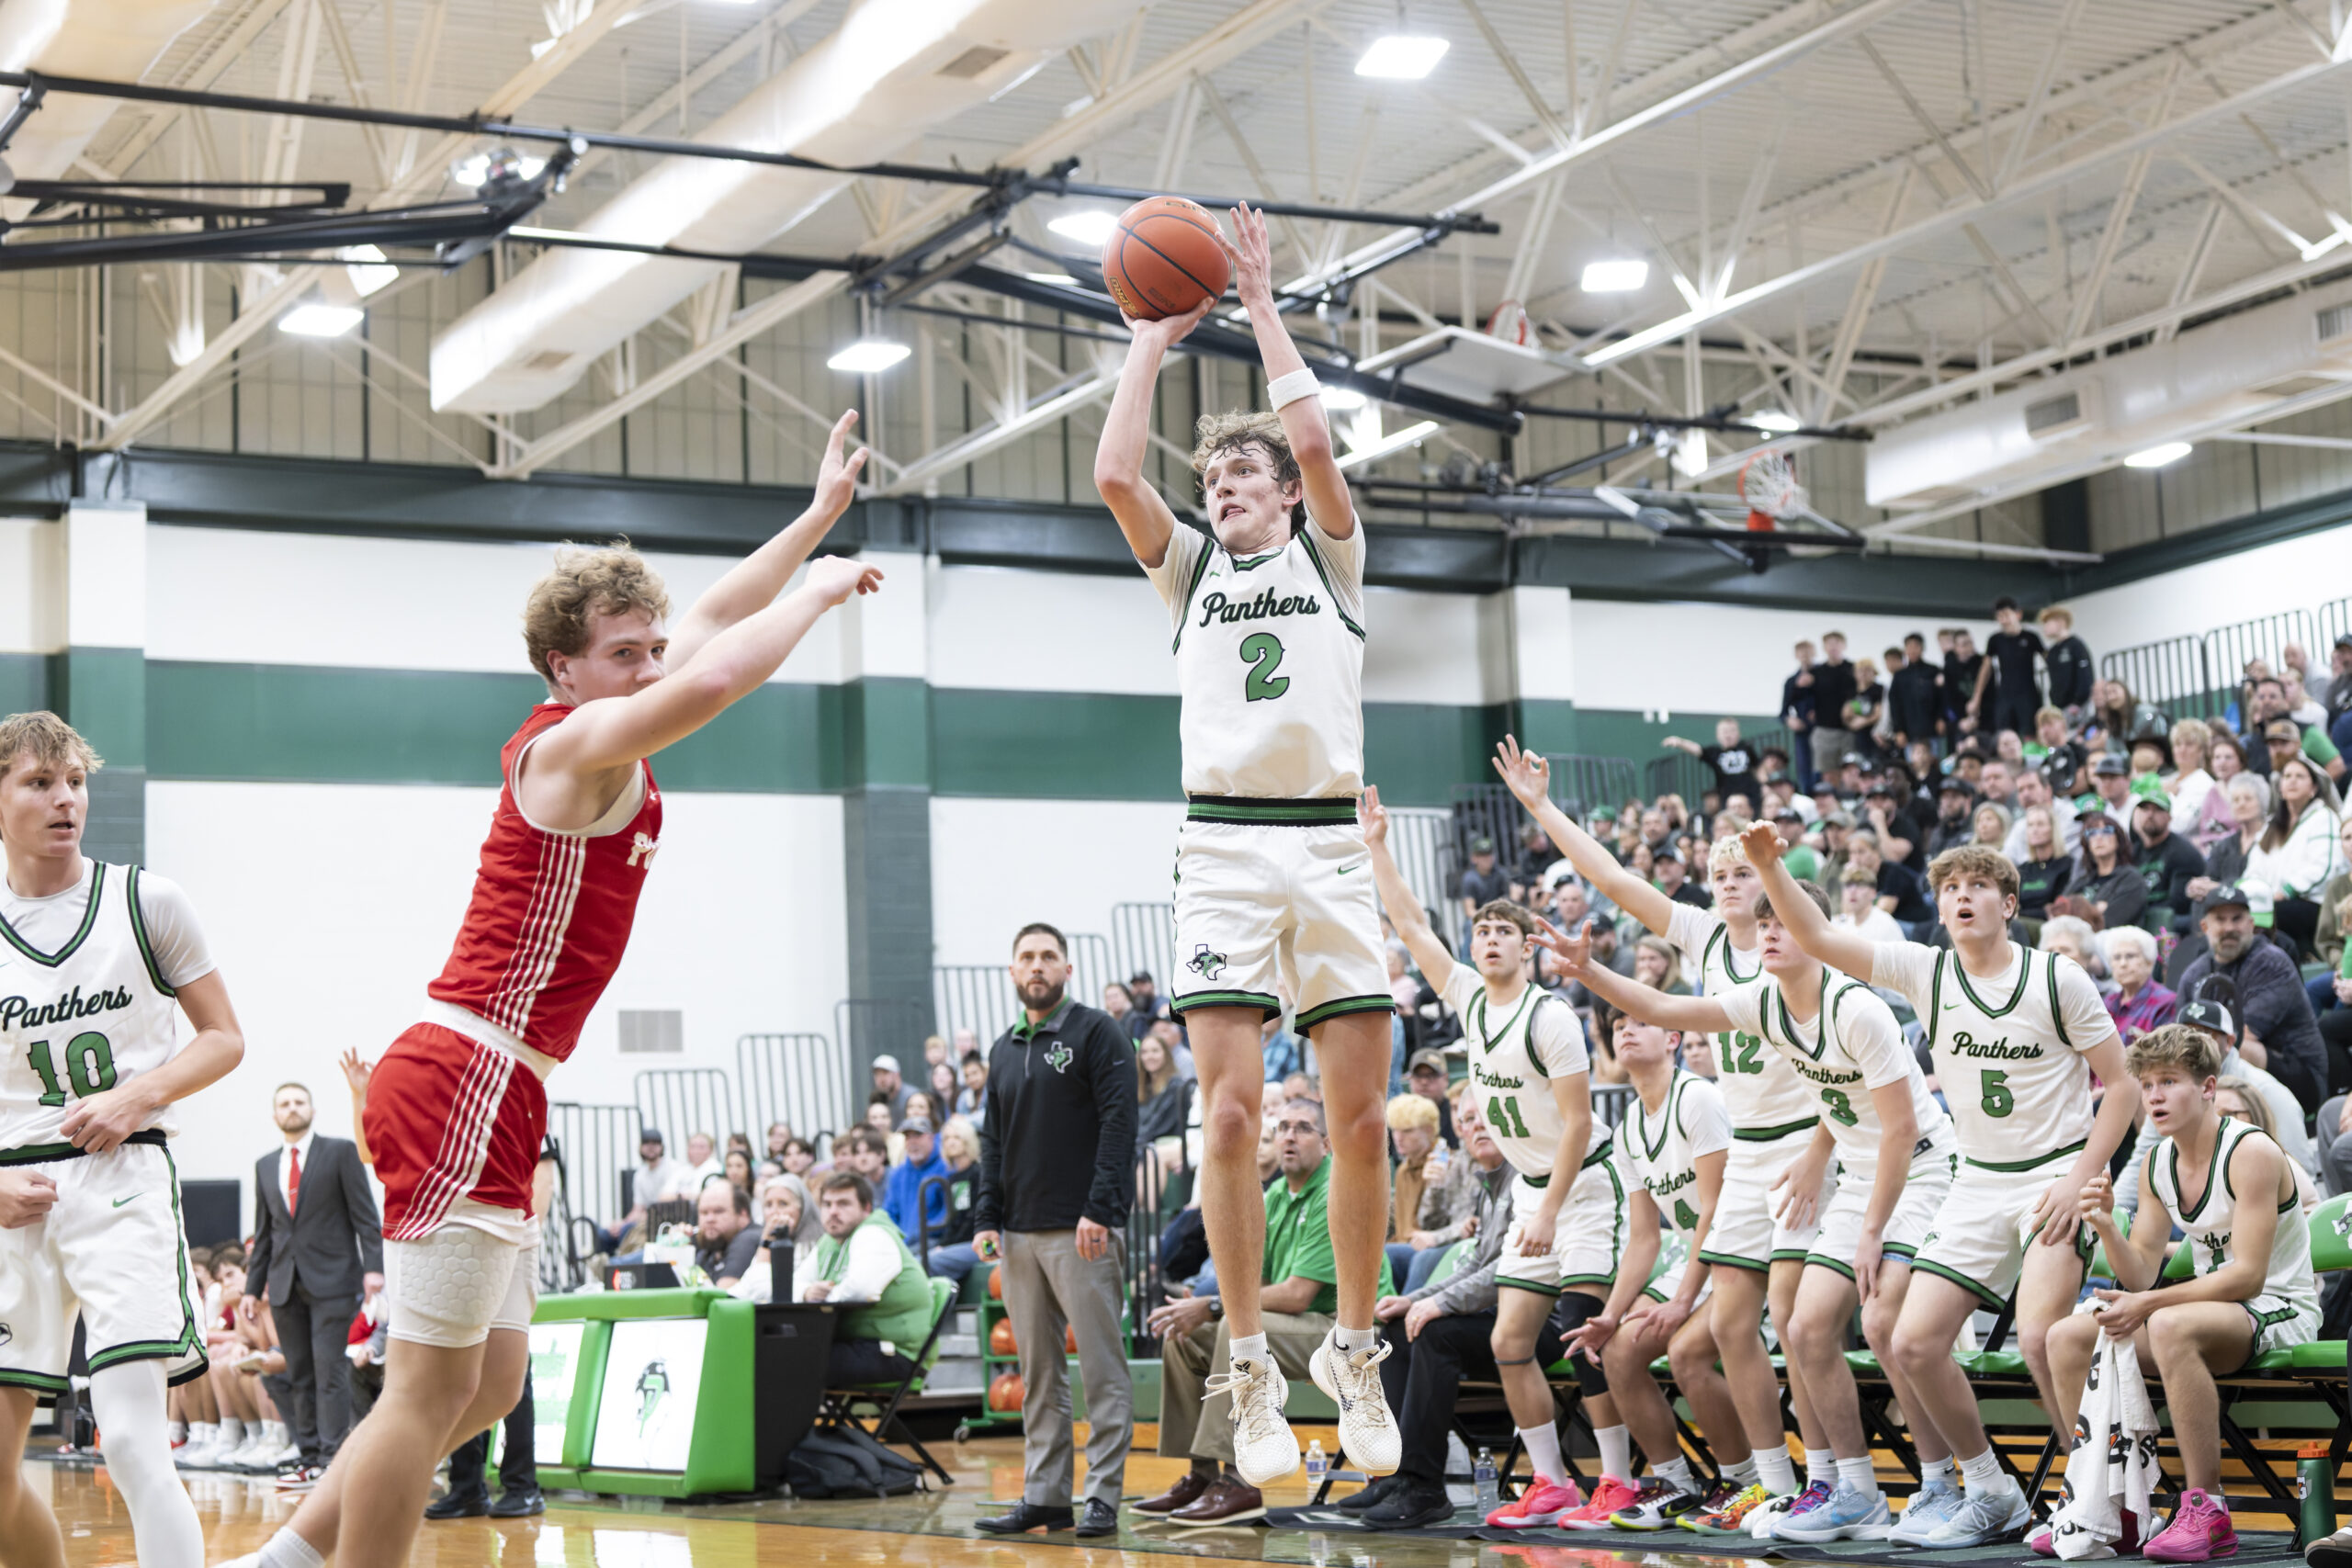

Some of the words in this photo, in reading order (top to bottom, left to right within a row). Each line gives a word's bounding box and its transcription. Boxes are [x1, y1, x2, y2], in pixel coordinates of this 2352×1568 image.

[1199, 586, 1321, 627] Panthers
[1239, 632, 1290, 702] 2
[0, 985, 133, 1032] Panthers
[1718, 1030, 1765, 1075] 12
[1951, 1031, 2044, 1060] Panthers
[27, 1031, 118, 1108] 10
[1792, 1058, 1863, 1085] Panthers
[1821, 1088, 1859, 1127] 3
[1981, 1069, 2015, 1118] 5
[1487, 1096, 1531, 1138] 41
[1644, 1168, 1696, 1196] Pthers
[1674, 1198, 1700, 1232] 4
